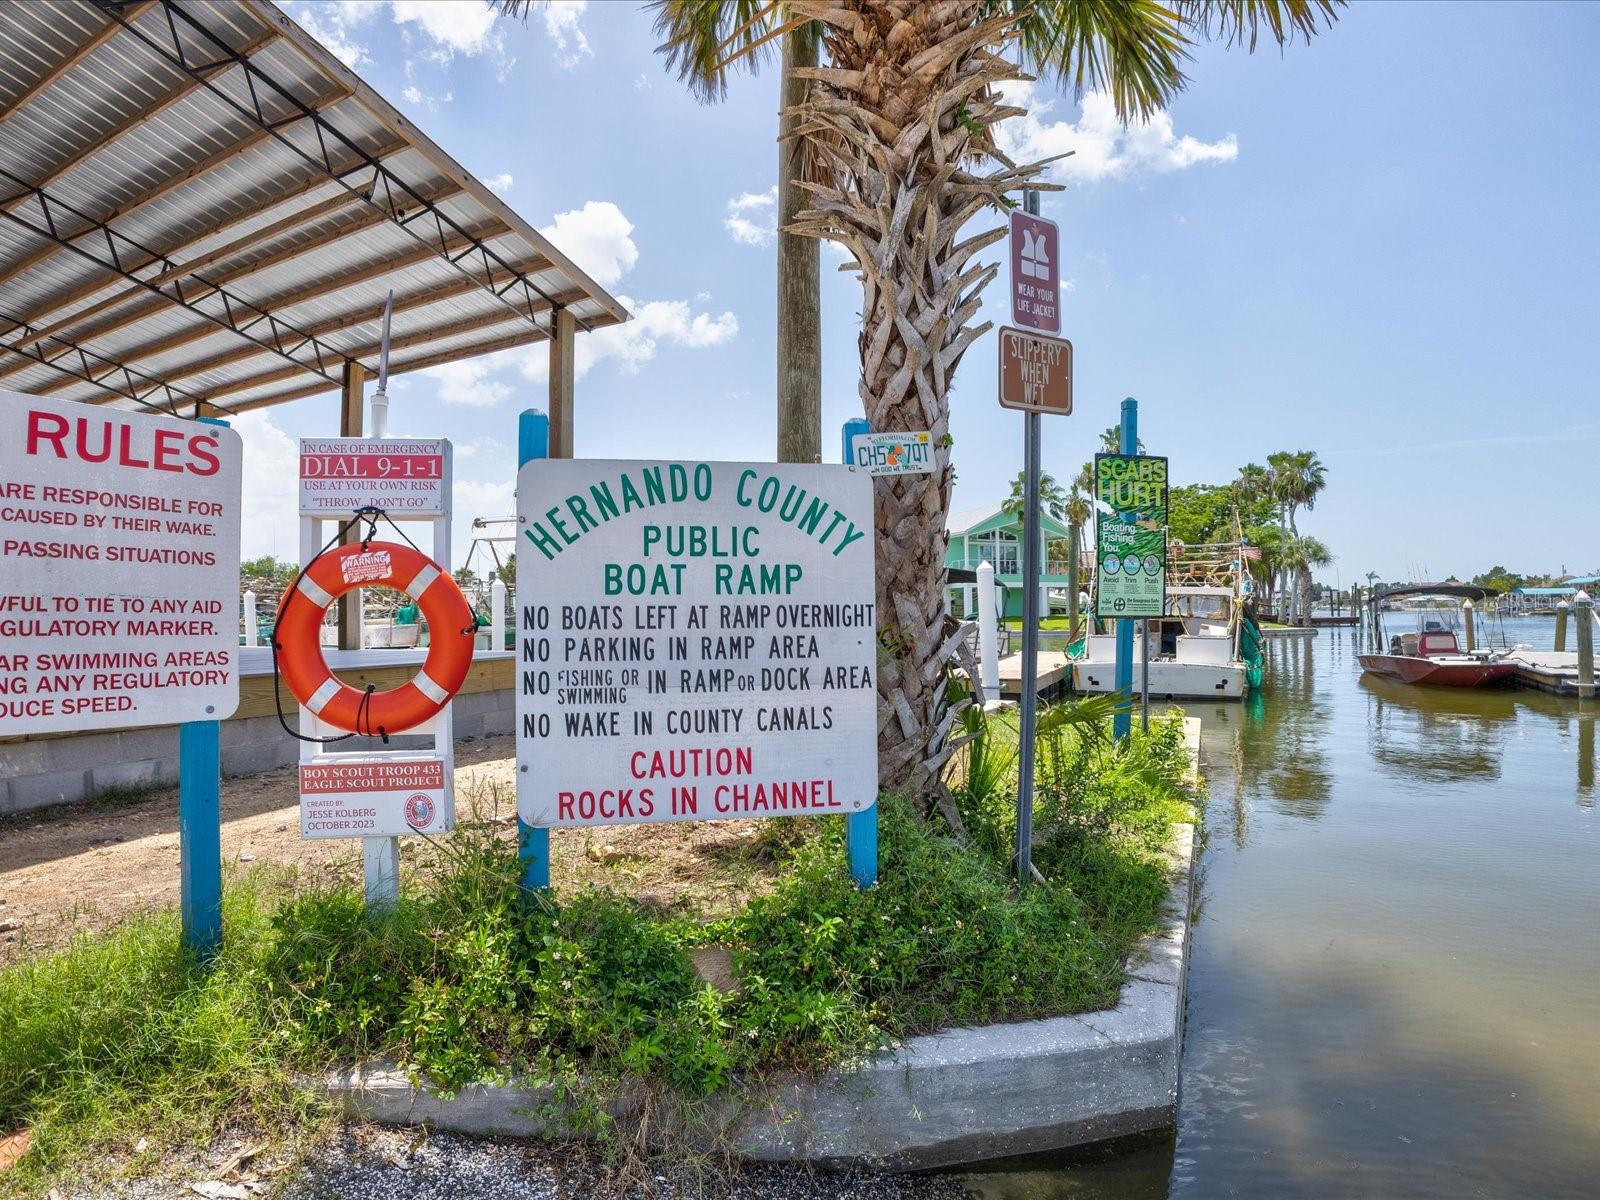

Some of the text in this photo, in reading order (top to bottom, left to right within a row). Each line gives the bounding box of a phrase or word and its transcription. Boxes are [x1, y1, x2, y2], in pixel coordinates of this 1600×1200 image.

[1017, 282, 1054, 303] WEAR YOUR
[1017, 299, 1055, 319] LIFE JACKET
[1011, 336, 1062, 367] SLIPPERY
[1020, 360, 1049, 385] WHEN
[1023, 382, 1045, 406] WET
[26, 409, 220, 477] RULES
[304, 444, 438, 454] IN CASE OF EMERGENCY
[302, 456, 439, 477] DIAL 9-1-1
[304, 480, 437, 490] USE AT YOUR OWN RISK
[1098, 480, 1166, 506] HURT
[43, 486, 182, 514] RESPONSIBLE
[188, 500, 223, 517] FOR
[524, 463, 865, 561] HERNANDO COUNTY
[1, 507, 216, 537] CAUSED BY THEIR WAKE.
[1102, 521, 1138, 534] Boating.
[642, 525, 760, 557] PUBLIC
[1103, 533, 1136, 544] Fishing.
[1103, 542, 1121, 552] You.
[4, 539, 216, 566] PASSING SITUATIONS
[346, 555, 387, 567] WARNING
[604, 563, 803, 595] BOAT RAMP
[52, 596, 79, 613] TO
[85, 597, 117, 613] TIE
[120, 598, 145, 614] TO
[150, 599, 189, 614] ANY
[191, 599, 222, 614] AID
[523, 603, 874, 630] NO BOATS LEFT AT RAMP OVERNIGHT
[127, 620, 218, 636] MARKER.
[523, 635, 820, 662] NO PARKING IN RAMP AREA
[36, 652, 157, 672] SWIMMING
[164, 650, 229, 668] AREAS
[36, 674, 86, 693] ANY
[93, 670, 229, 691] REGULATORY
[523, 670, 549, 695] NO
[558, 669, 613, 687] FISHING
[622, 669, 639, 686] OR
[648, 670, 666, 694] IN
[680, 669, 735, 693] RAMP
[761, 667, 811, 691] DOCK
[823, 666, 873, 690] AREA
[61, 695, 137, 714] SPEED.
[558, 688, 627, 705] SWIMMING
[523, 706, 833, 738] NO WAKE IN COUNTY CANALS
[304, 765, 441, 779] BOY SCOUT TROOP 433
[630, 747, 752, 779] CAUTION
[304, 776, 442, 790] EAGLE SCOUT PROJECT
[307, 800, 334, 808] CREATED
[558, 780, 841, 820] ROCKS IN CHANNEL
[307, 820, 375, 830] OCTOBER 2023
[308, 809, 376, 819] JESSE KOLBERG
